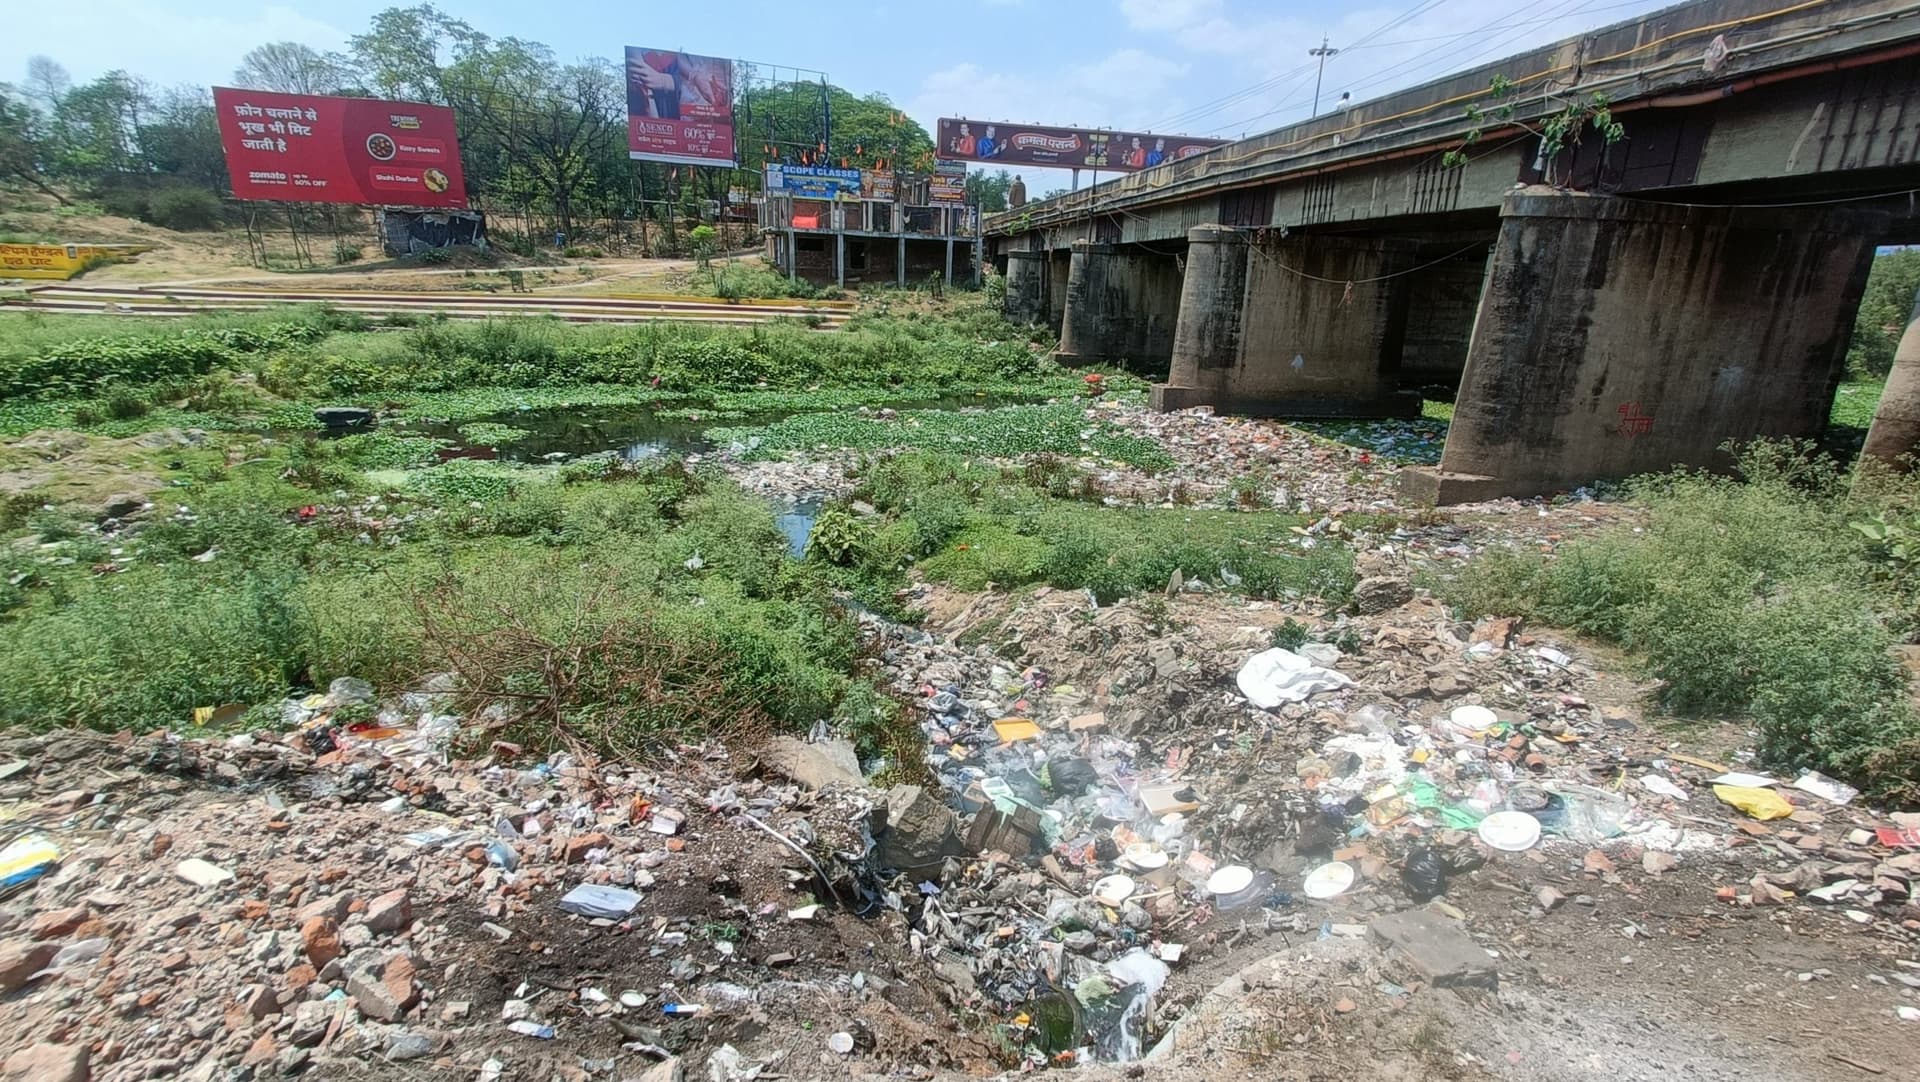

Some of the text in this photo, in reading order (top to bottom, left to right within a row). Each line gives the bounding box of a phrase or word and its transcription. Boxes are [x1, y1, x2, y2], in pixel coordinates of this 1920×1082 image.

[264, 107, 303, 120] चलाने
[304, 107, 317, 121] से
[238, 121, 312, 136] भूख भी मिट
[646, 123, 673, 132] SENCO
[241, 137, 287, 152] जाती है
[1018, 135, 1047, 146] कमला
[248, 171, 286, 180] zomato
[783, 165, 859, 178] SCOPE CLASSES
